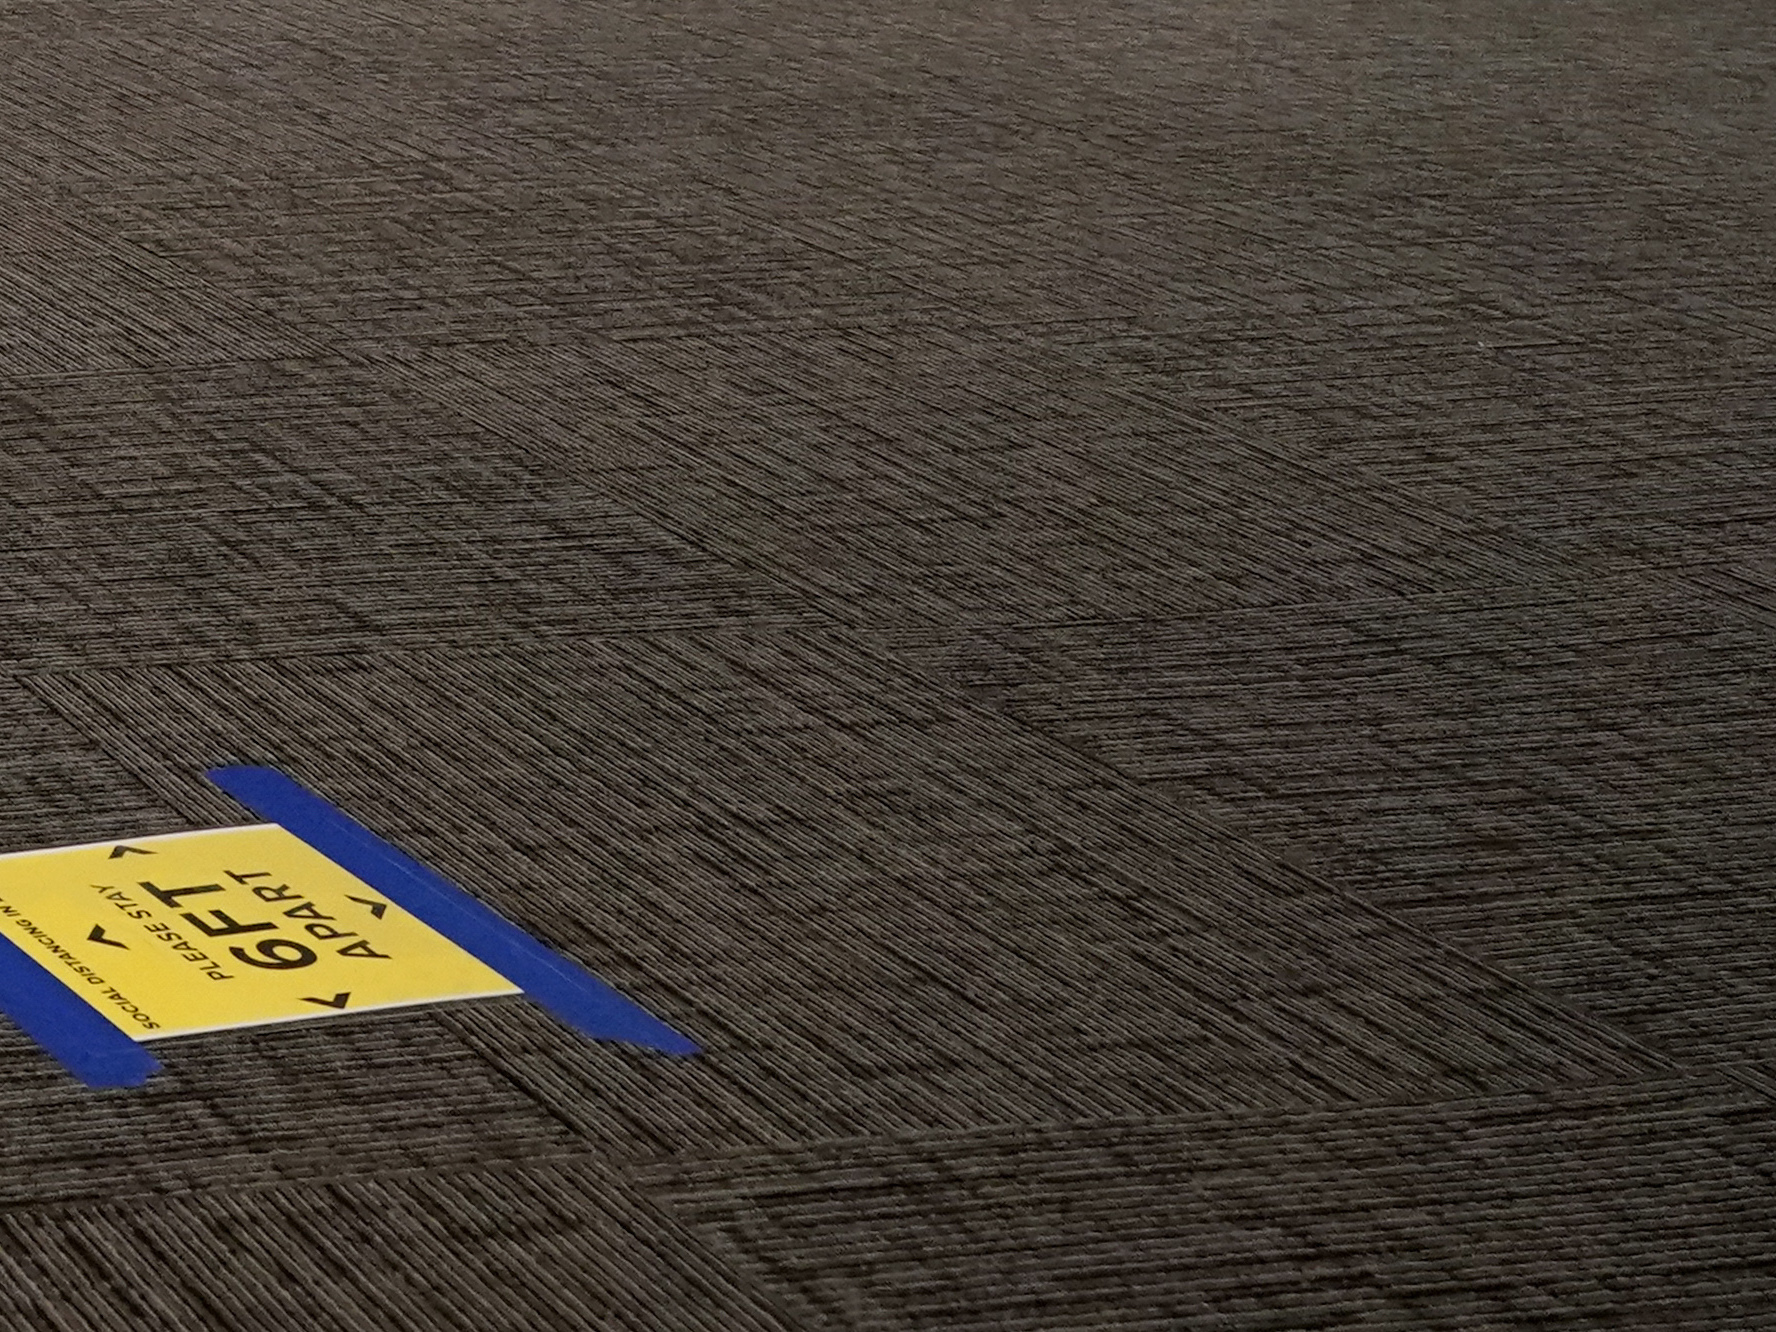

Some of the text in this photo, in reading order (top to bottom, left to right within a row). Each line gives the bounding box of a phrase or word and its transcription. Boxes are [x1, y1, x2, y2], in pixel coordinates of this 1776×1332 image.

[16, 918, 103, 986] DISTANCING
[90, 884, 235, 981] PLEASE STAY
[136, 881, 317, 970] 6FT
[223, 869, 392, 959] APART
[102, 986, 161, 1030] SOCIAL
